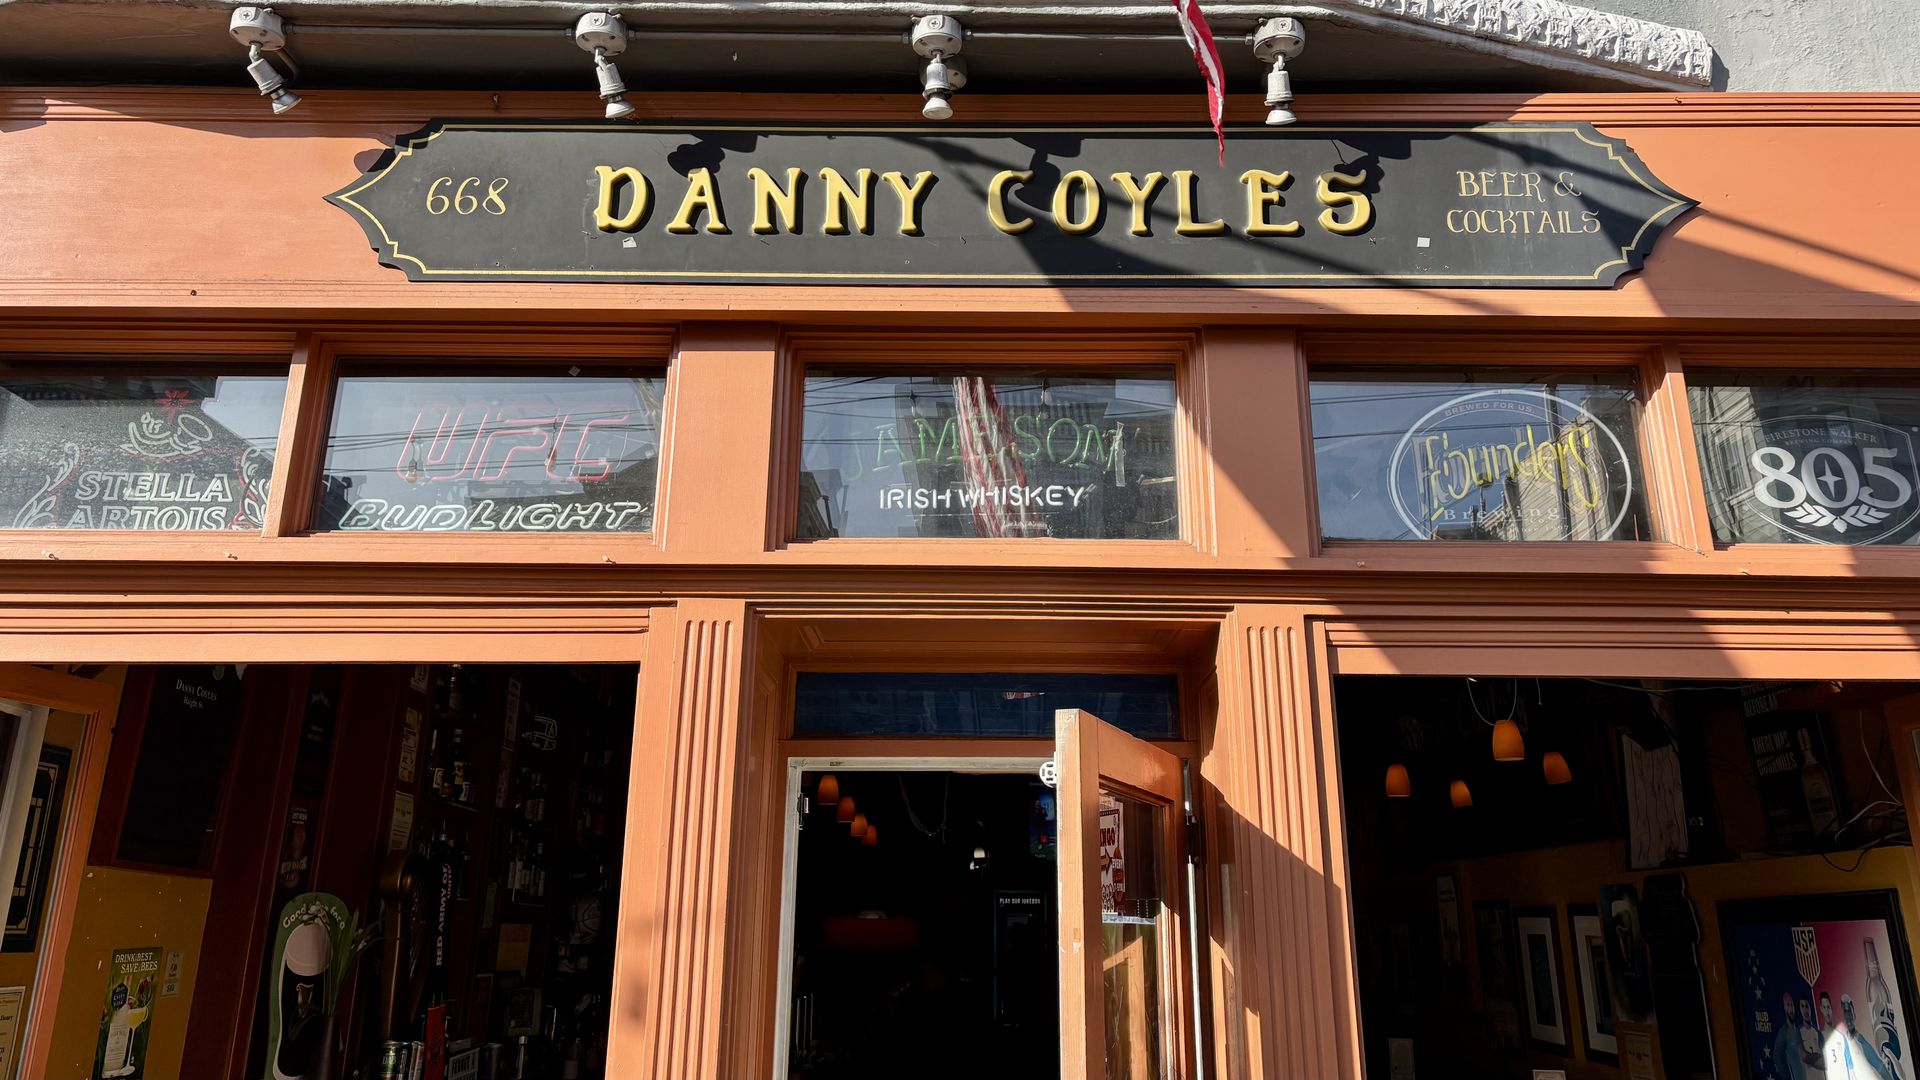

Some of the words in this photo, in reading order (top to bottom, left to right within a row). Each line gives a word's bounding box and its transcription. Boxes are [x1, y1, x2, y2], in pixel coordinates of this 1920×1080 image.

[426, 176, 510, 216] 668
[1456, 170, 1546, 203] BEER
[1553, 171, 1582, 197] &
[594, 165, 935, 235] DANNY
[987, 168, 1375, 235] COYLES
[1446, 209, 1600, 234] COCKTAILS
[1445, 402, 1489, 417] BREWED
[1493, 401, 1514, 410] FOR
[397, 403, 630, 481] UFC
[1765, 428, 1826, 443] FIRESTONE
[1828, 429, 1878, 444] WALKER
[75, 471, 233, 502] STELLA
[1752, 447, 1912, 509] 805
[880, 487, 951, 509] IRISH
[957, 485, 1085, 509] WHISKEY
[65, 505, 227, 530] ARTOIS
[1793, 929, 1815, 953] USA
[115, 953, 135, 963] DRINK
[137, 952, 153, 962] BEST
[121, 963, 138, 974] SAVE
[141, 961, 158, 971] BEES
